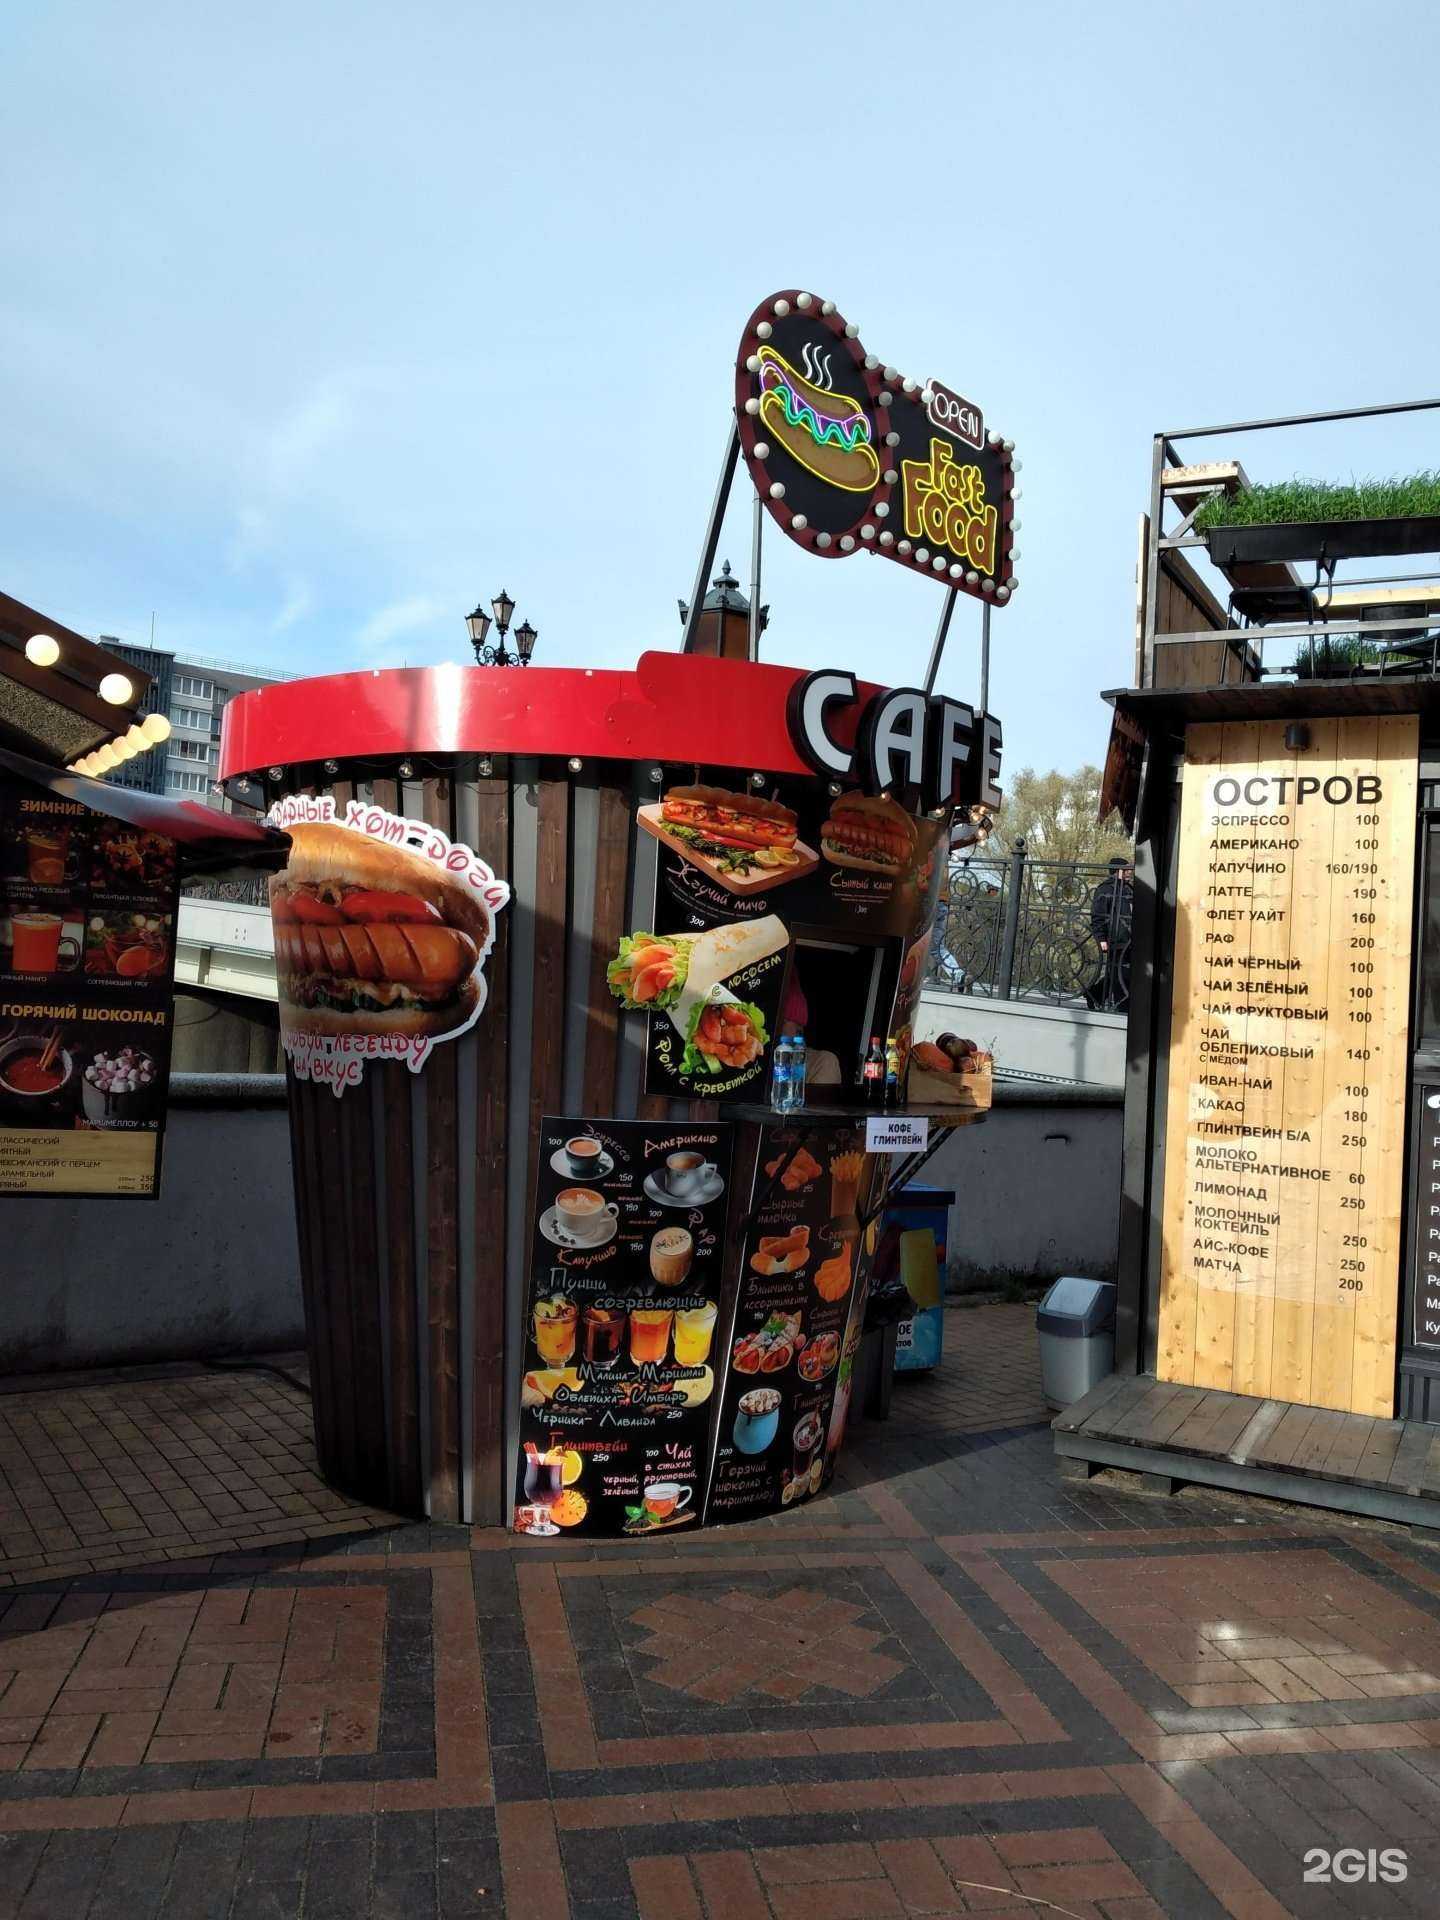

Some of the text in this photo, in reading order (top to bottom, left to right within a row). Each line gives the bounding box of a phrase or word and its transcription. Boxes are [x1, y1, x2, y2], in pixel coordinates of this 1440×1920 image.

[934, 393, 978, 439] OPEN
[931, 438, 985, 514] Fast
[902, 459, 998, 575] Food
[802, 669, 1003, 812] CAFE
[1213, 775, 1383, 806] ОСТРОВ
[20, 800, 85, 815] ЗИМНИЕ
[1211, 815, 1379, 826] ЭСПРЕССО 100
[1210, 839, 1379, 850] АМЕРИКАНО 100
[1209, 863, 1378, 875] КАПУЧИНО 160/190
[1208, 886, 1377, 899] ЛАТТЕ 190
[689, 915, 705, 927] 300
[1207, 908, 1376, 924] ФЛЕТ УАЙТ 160
[1205, 933, 1375, 948] РАФ 200
[1204, 956, 1374, 973] ЧАЙ ЧЁРНЫЙ 100
[748, 978, 760, 990] 350
[1203, 980, 1373, 998] ЧАЙ ЗЕЛЁНЫЙ 100
[1, 1004, 166, 1026] ГОРЯЧИЙ ШОКОЛАД
[1202, 1003, 1372, 1023] ЧАЙ ФРУКТОВЫЙ 100
[654, 1022, 669, 1030] 350
[1200, 1028, 1230, 1039] ЧАЙ
[1200, 1042, 1370, 1060] ОБЛЕПИХОВЫЙ 140
[1199, 1055, 1248, 1065] С МЁДОМ
[1199, 1075, 1369, 1097] ИВАН-ЧАЙ 100
[1198, 1098, 1368, 1122] КАКАО 180
[889, 1124, 912, 1133] КОФЕ
[1197, 1121, 1367, 1147] ГЛИНТВЕЙН Б/А 250
[548, 1137, 562, 1145] 100
[644, 1135, 718, 1158] Американо
[874, 1133, 922, 1144] ГЛИНТВЕЙН
[1196, 1146, 1257, 1161] МОЛОКО
[0, 1159, 59, 1168] ЕКСИКАНСКИЙ
[1195, 1158, 1365, 1185] АЛЬТЕРНАТИВНОЕ 60
[0, 1170, 54, 1178] АРАМЕЛЬНЫЙ
[1194, 1181, 1365, 1210] ЛИМОНАД 250
[1195, 1205, 1281, 1226] МОЛОЧНЫЙ
[1194, 1218, 1368, 1248] КОКТЕЙЛЬ 250
[696, 1248, 712, 1256] 200
[1193, 1238, 1365, 1272] АЙС-КОФЕ 250
[1194, 1256, 1364, 1291] МАТЧА 200
[667, 1410, 682, 1419] 250
[593, 1454, 609, 1462] 250
